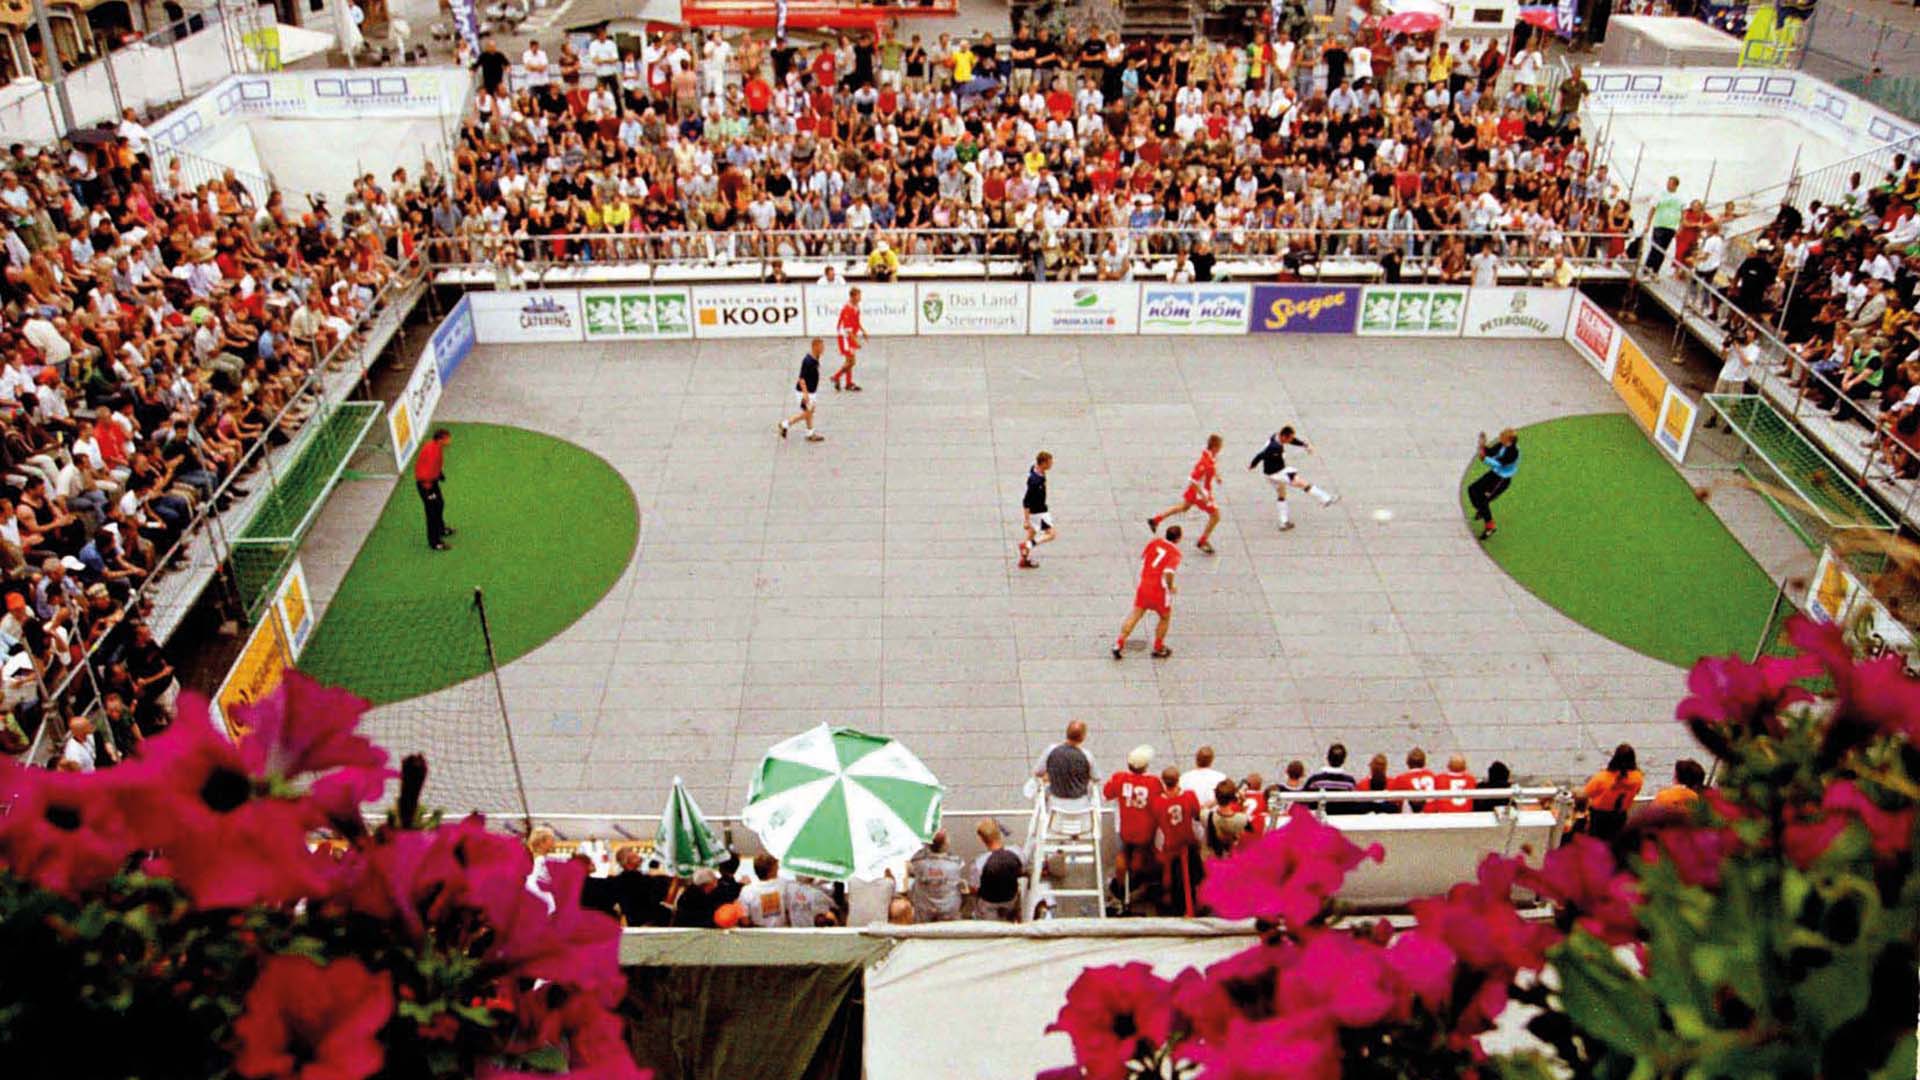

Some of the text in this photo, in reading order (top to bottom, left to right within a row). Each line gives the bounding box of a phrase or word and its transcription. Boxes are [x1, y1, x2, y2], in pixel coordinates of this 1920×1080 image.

[949, 291, 1019, 307] Das Land
[520, 312, 572, 329] CATERING
[722, 307, 798, 325] KOOP
[945, 313, 1016, 327] Steiermark
[1151, 546, 1166, 568] 7
[1450, 779, 1467, 807] 5
[1167, 804, 1183, 826] 3
